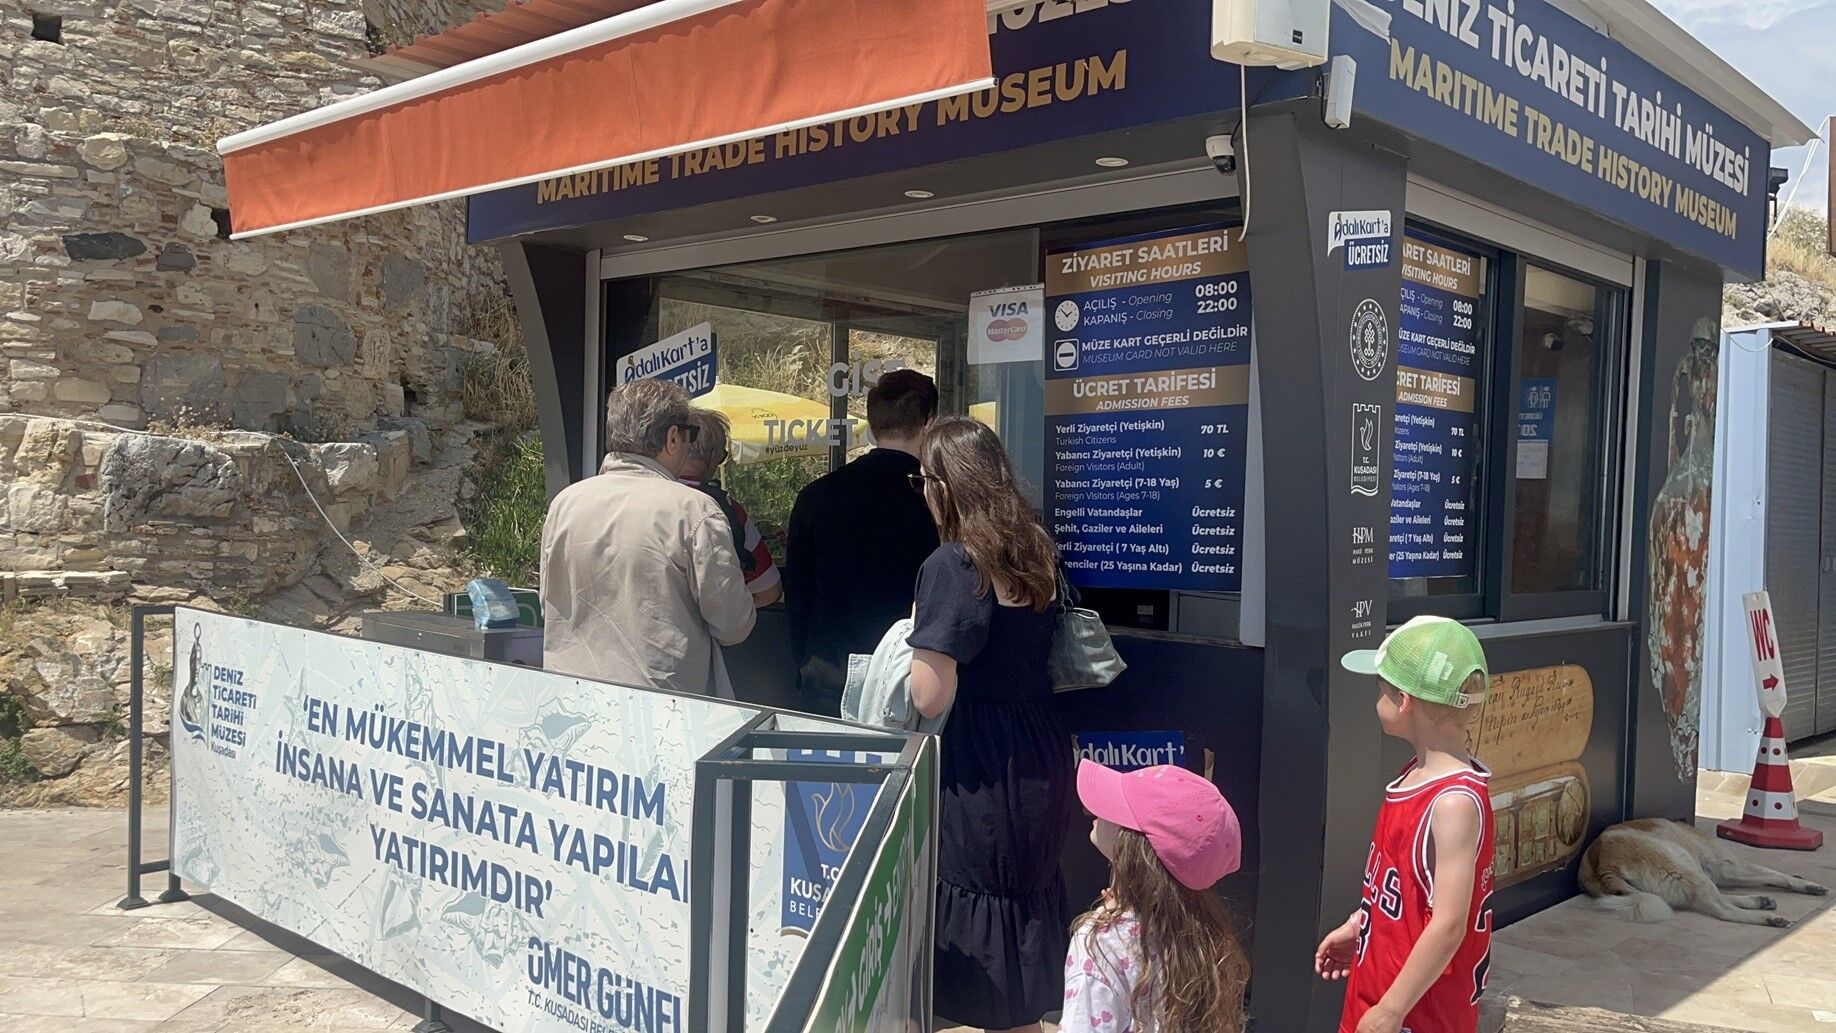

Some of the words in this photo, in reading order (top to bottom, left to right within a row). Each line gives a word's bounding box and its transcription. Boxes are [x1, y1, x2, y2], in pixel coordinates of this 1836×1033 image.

[1487, 1, 1606, 119] TİCARETİ
[1612, 80, 1682, 159] TARİHİ
[1685, 123, 1750, 197] MÜZESİ
[537, 159, 660, 204] MARITIME
[668, 136, 766, 180] TRADE
[774, 103, 925, 160] HISTORY
[936, 49, 1127, 127] MUSEUM
[1389, 37, 1519, 138] MARITIME
[1523, 105, 1594, 174] TRADE
[1597, 144, 1672, 209] HISTORY
[1674, 182, 1738, 241] MUSEUM
[1062, 249, 1133, 274] ZİYARET
[1138, 230, 1228, 263] SAATLERİ
[1347, 240, 1389, 266] ÜCRETSİZ
[1426, 248, 1471, 276] SAATLERİ
[1090, 270, 1147, 288] VISITING
[1150, 262, 1201, 280] HOURS
[1432, 273, 1458, 290] HOURS
[1083, 297, 1117, 311] AÇILIŞ
[1128, 293, 1173, 306] Opening
[1195, 281, 1237, 298] 08:00
[986, 301, 1029, 318] VISA
[1083, 313, 1128, 327] KAPANIŞ
[1136, 307, 1173, 321] Closing
[1196, 297, 1237, 314] 22:00
[1453, 300, 1473, 315] 08:00
[1453, 315, 1472, 329] 22:00
[1082, 339, 1111, 352] MÜZE
[1113, 337, 1141, 349] KART
[1144, 330, 1190, 348] GEÇERLİ
[1193, 324, 1248, 341] DEĞİLDİR
[1410, 332, 1427, 344] KART
[1426, 336, 1450, 349] GEÇERLİ
[1450, 340, 1476, 354] DEĞİLDİR
[1083, 352, 1124, 365] MUSEUM
[1125, 350, 1152, 361] CARD
[1154, 348, 1175, 359] NOT
[1177, 344, 1207, 357] VALID
[1209, 341, 1237, 353] HERE
[1073, 379, 1130, 398] ÜCRET
[1134, 367, 1216, 393] TARİFESİ
[1421, 373, 1461, 396] TARİFESİ
[1096, 398, 1158, 411] ADMISSION
[1160, 395, 1190, 407] FEES
[1398, 391, 1432, 405] ADMISSION
[1433, 395, 1448, 407] FEES
[763, 418, 859, 447] TICKET
[1055, 424, 1076, 435] Yerli
[1077, 422, 1118, 435] Ziyaretçi
[1119, 420, 1165, 433] (Yetişkin)
[1200, 425, 1213, 435] 70
[1216, 424, 1229, 434] TL
[1451, 427, 1458, 436] 70
[1055, 436, 1084, 446] Turkish
[1085, 435, 1117, 444] Citizens
[1394, 440, 1418, 453] Ziyaretçi
[1055, 451, 1090, 461] Yabancı
[1092, 448, 1133, 461] Ziyaretçi
[1135, 446, 1182, 459] (Yetişkin)
[1202, 449, 1214, 458] 10
[1217, 448, 1226, 458] €
[1055, 463, 1085, 474] Foreign
[1086, 462, 1115, 471] Visitors
[1116, 461, 1145, 473] (Adult)
[1393, 468, 1417, 481] Ziyaretçi
[1055, 479, 1090, 488] Yabancı
[1092, 477, 1133, 490] Ziyaretçi
[1135, 478, 1157, 489] (7-18
[1159, 477, 1180, 489] Yaş)
[1204, 479, 1212, 488] 5
[1214, 479, 1223, 488] €
[1055, 492, 1085, 502] Foreign
[1086, 491, 1115, 500] Visitors
[1116, 491, 1140, 502] (Ages
[1141, 490, 1161, 501] 7-18)
[1444, 499, 1465, 510] Ücretsiz
[1055, 508, 1085, 518] Engelli
[1086, 508, 1143, 519] Vatandaşlar
[1191, 506, 1235, 517] Ücretsiz
[1444, 515, 1464, 526] Ücretsiz
[1054, 524, 1080, 535] Şehit,
[1081, 524, 1113, 534] Gaziler
[1115, 526, 1126, 534] ve
[1128, 524, 1163, 534] Aileleri
[1191, 524, 1235, 536] Ücretsiz
[1443, 532, 1464, 543] Ücretsiz
[1073, 543, 1114, 554] Ziyaretçi
[1129, 543, 1146, 554] Yaş
[1148, 543, 1169, 555] Altı)
[1191, 543, 1235, 555] Ücretsiz
[1443, 549, 1463, 559] Ücretsiz
[1100, 561, 1114, 572] (25
[1116, 562, 1148, 572] Yaşına
[1150, 562, 1182, 573] Kadar)
[1191, 562, 1235, 574] Ücretsiz
[1750, 608, 1775, 662] WC
[213, 665, 244, 686] DENİZ
[212, 684, 257, 709] TİCARETİ
[211, 703, 244, 726] TARİHİ
[211, 722, 246, 747] MÜZESİ
[210, 741, 236, 759] Kuşadası
[345, 703, 514, 784] MÜKEMMEL
[524, 747, 666, 826] YATIRIM
[275, 730, 364, 800] İNSANA
[369, 768, 404, 815] VE
[410, 781, 540, 855] SANATA
[527, 989, 543, 1010] T.C.
[544, 999, 588, 1033] KUŞADASI
